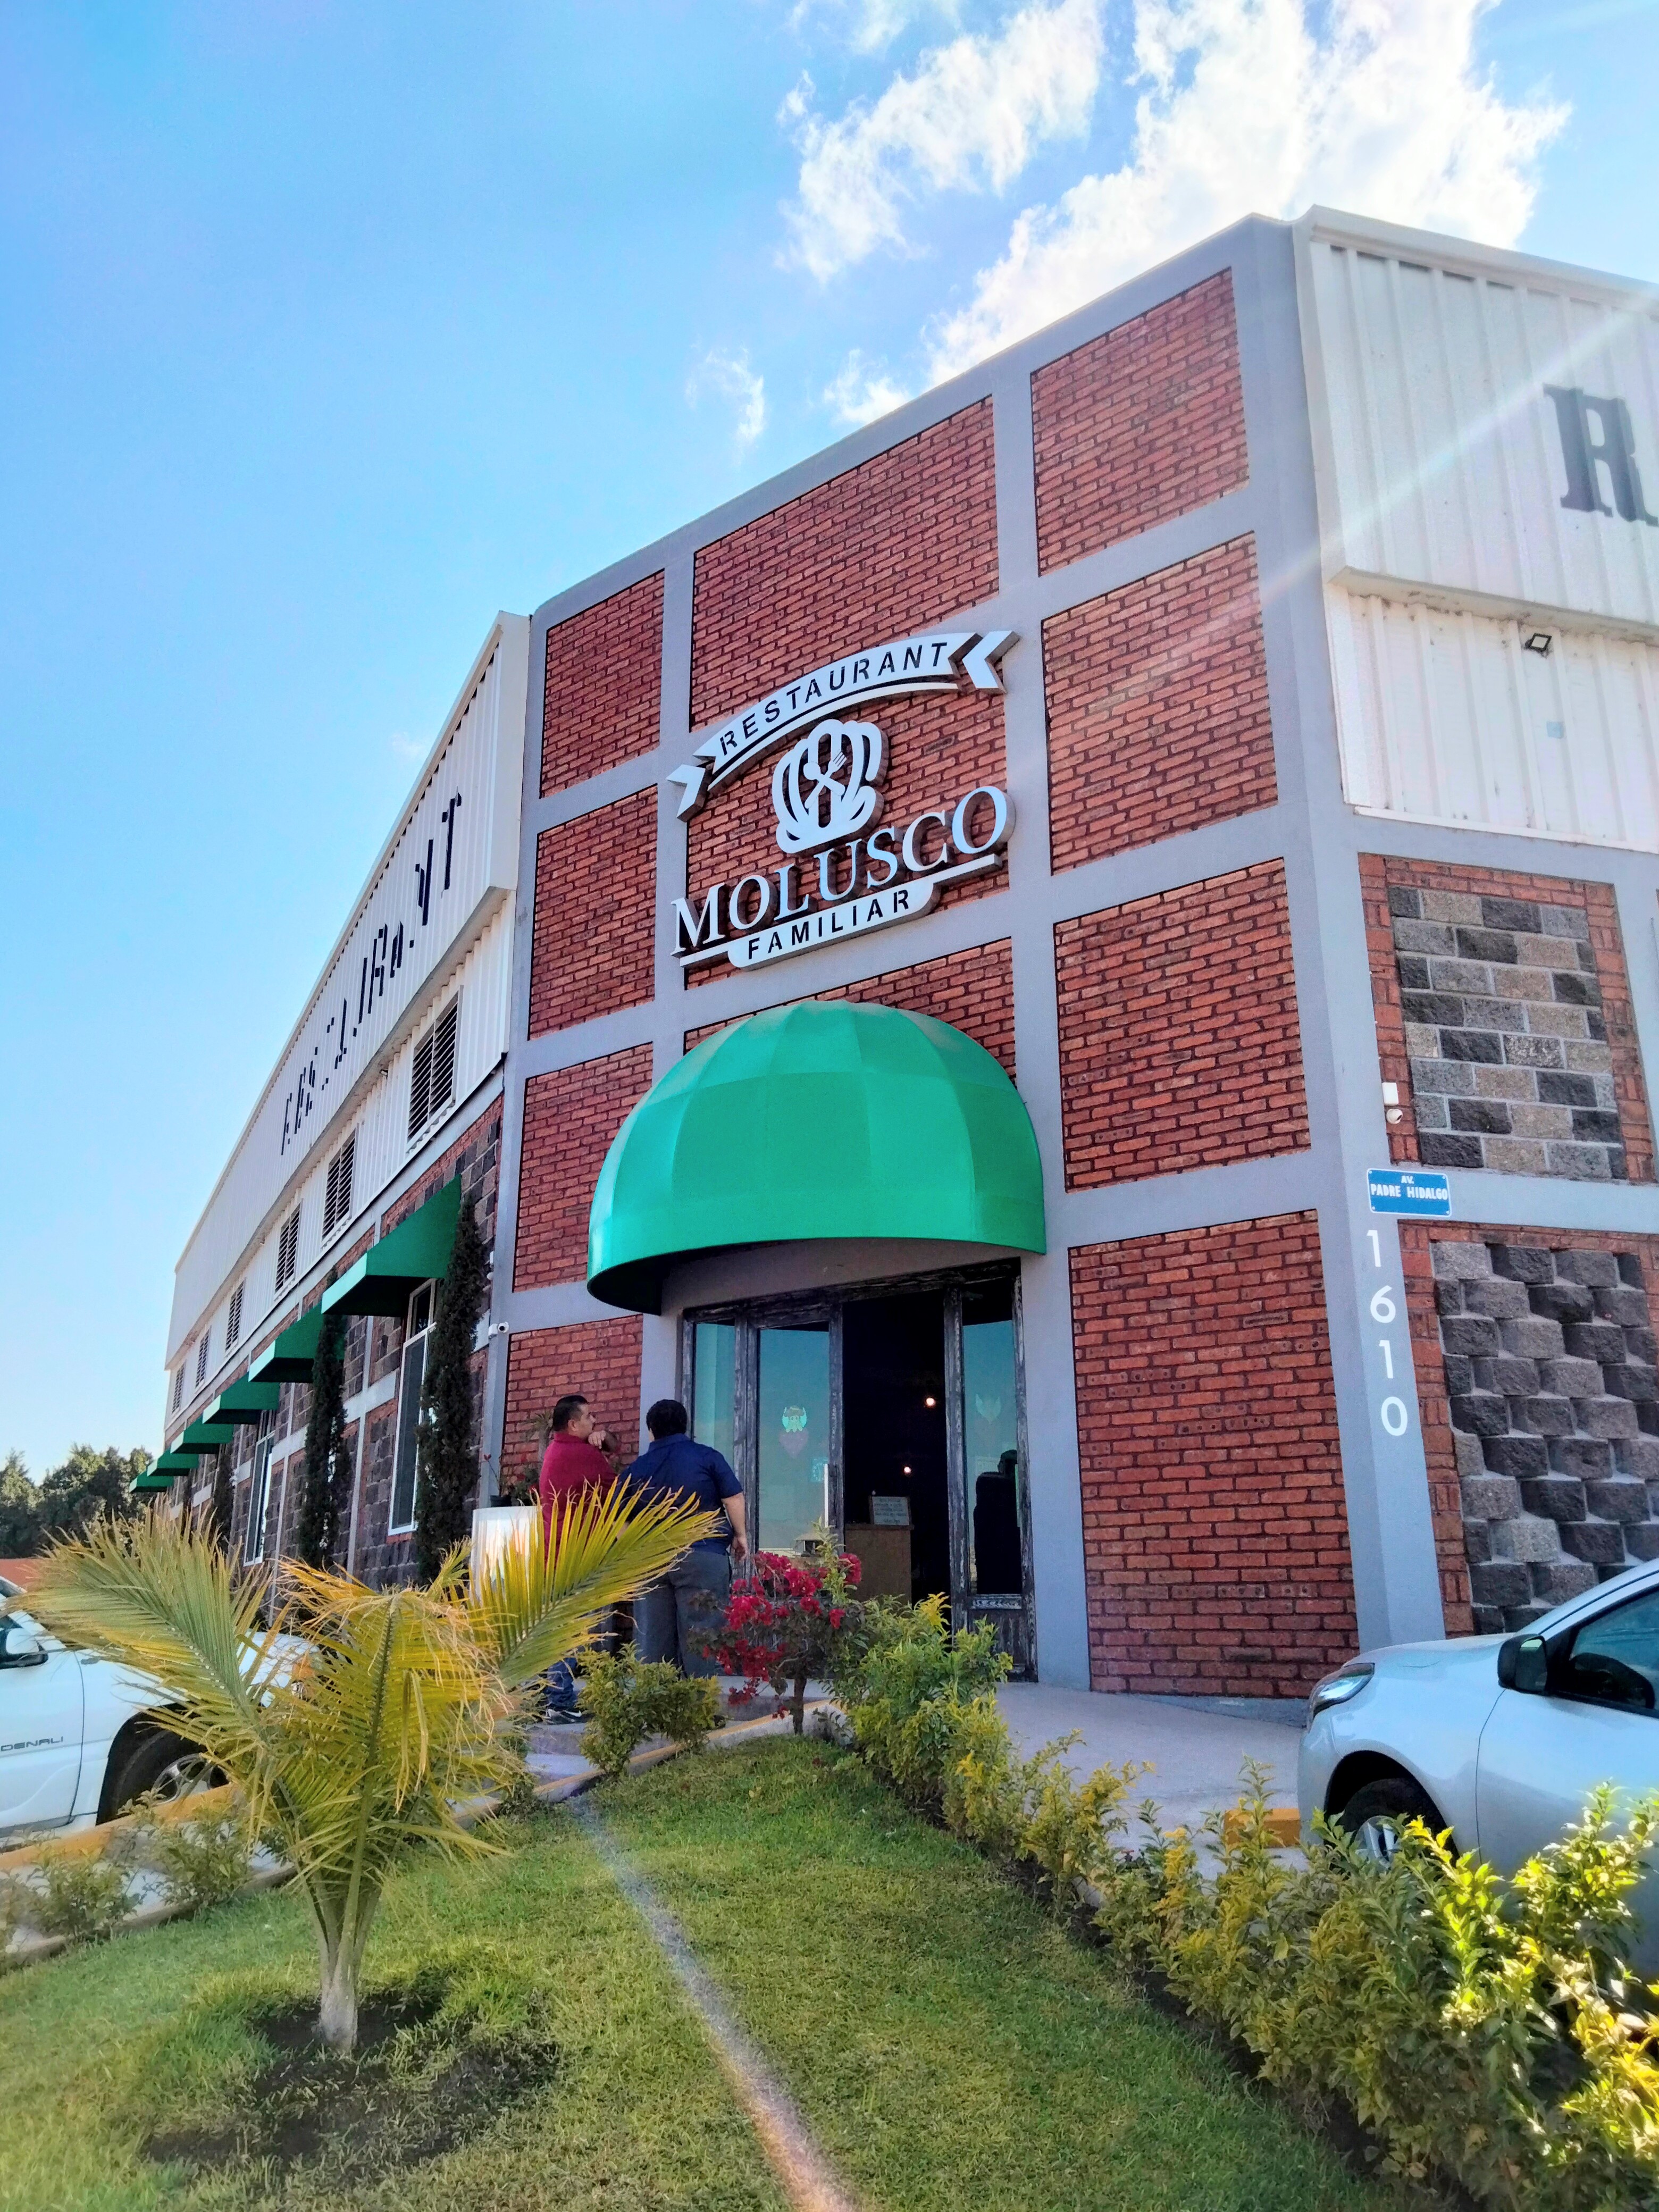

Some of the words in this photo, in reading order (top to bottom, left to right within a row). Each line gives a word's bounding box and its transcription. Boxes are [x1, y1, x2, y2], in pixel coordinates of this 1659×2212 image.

[719, 641, 949, 756] RESTAURANT
[670, 786, 1010, 957] MOLUSCO
[748, 890, 910, 960] FAMILIAR
[1370, 1183, 1401, 1197] PADRE
[1406, 1186, 1448, 1200] HIDALGO
[1401, 1175, 1414, 1184] AV.
[1366, 1229, 1408, 1436] 1610
[1, 1736, 63, 1752] DENALI
